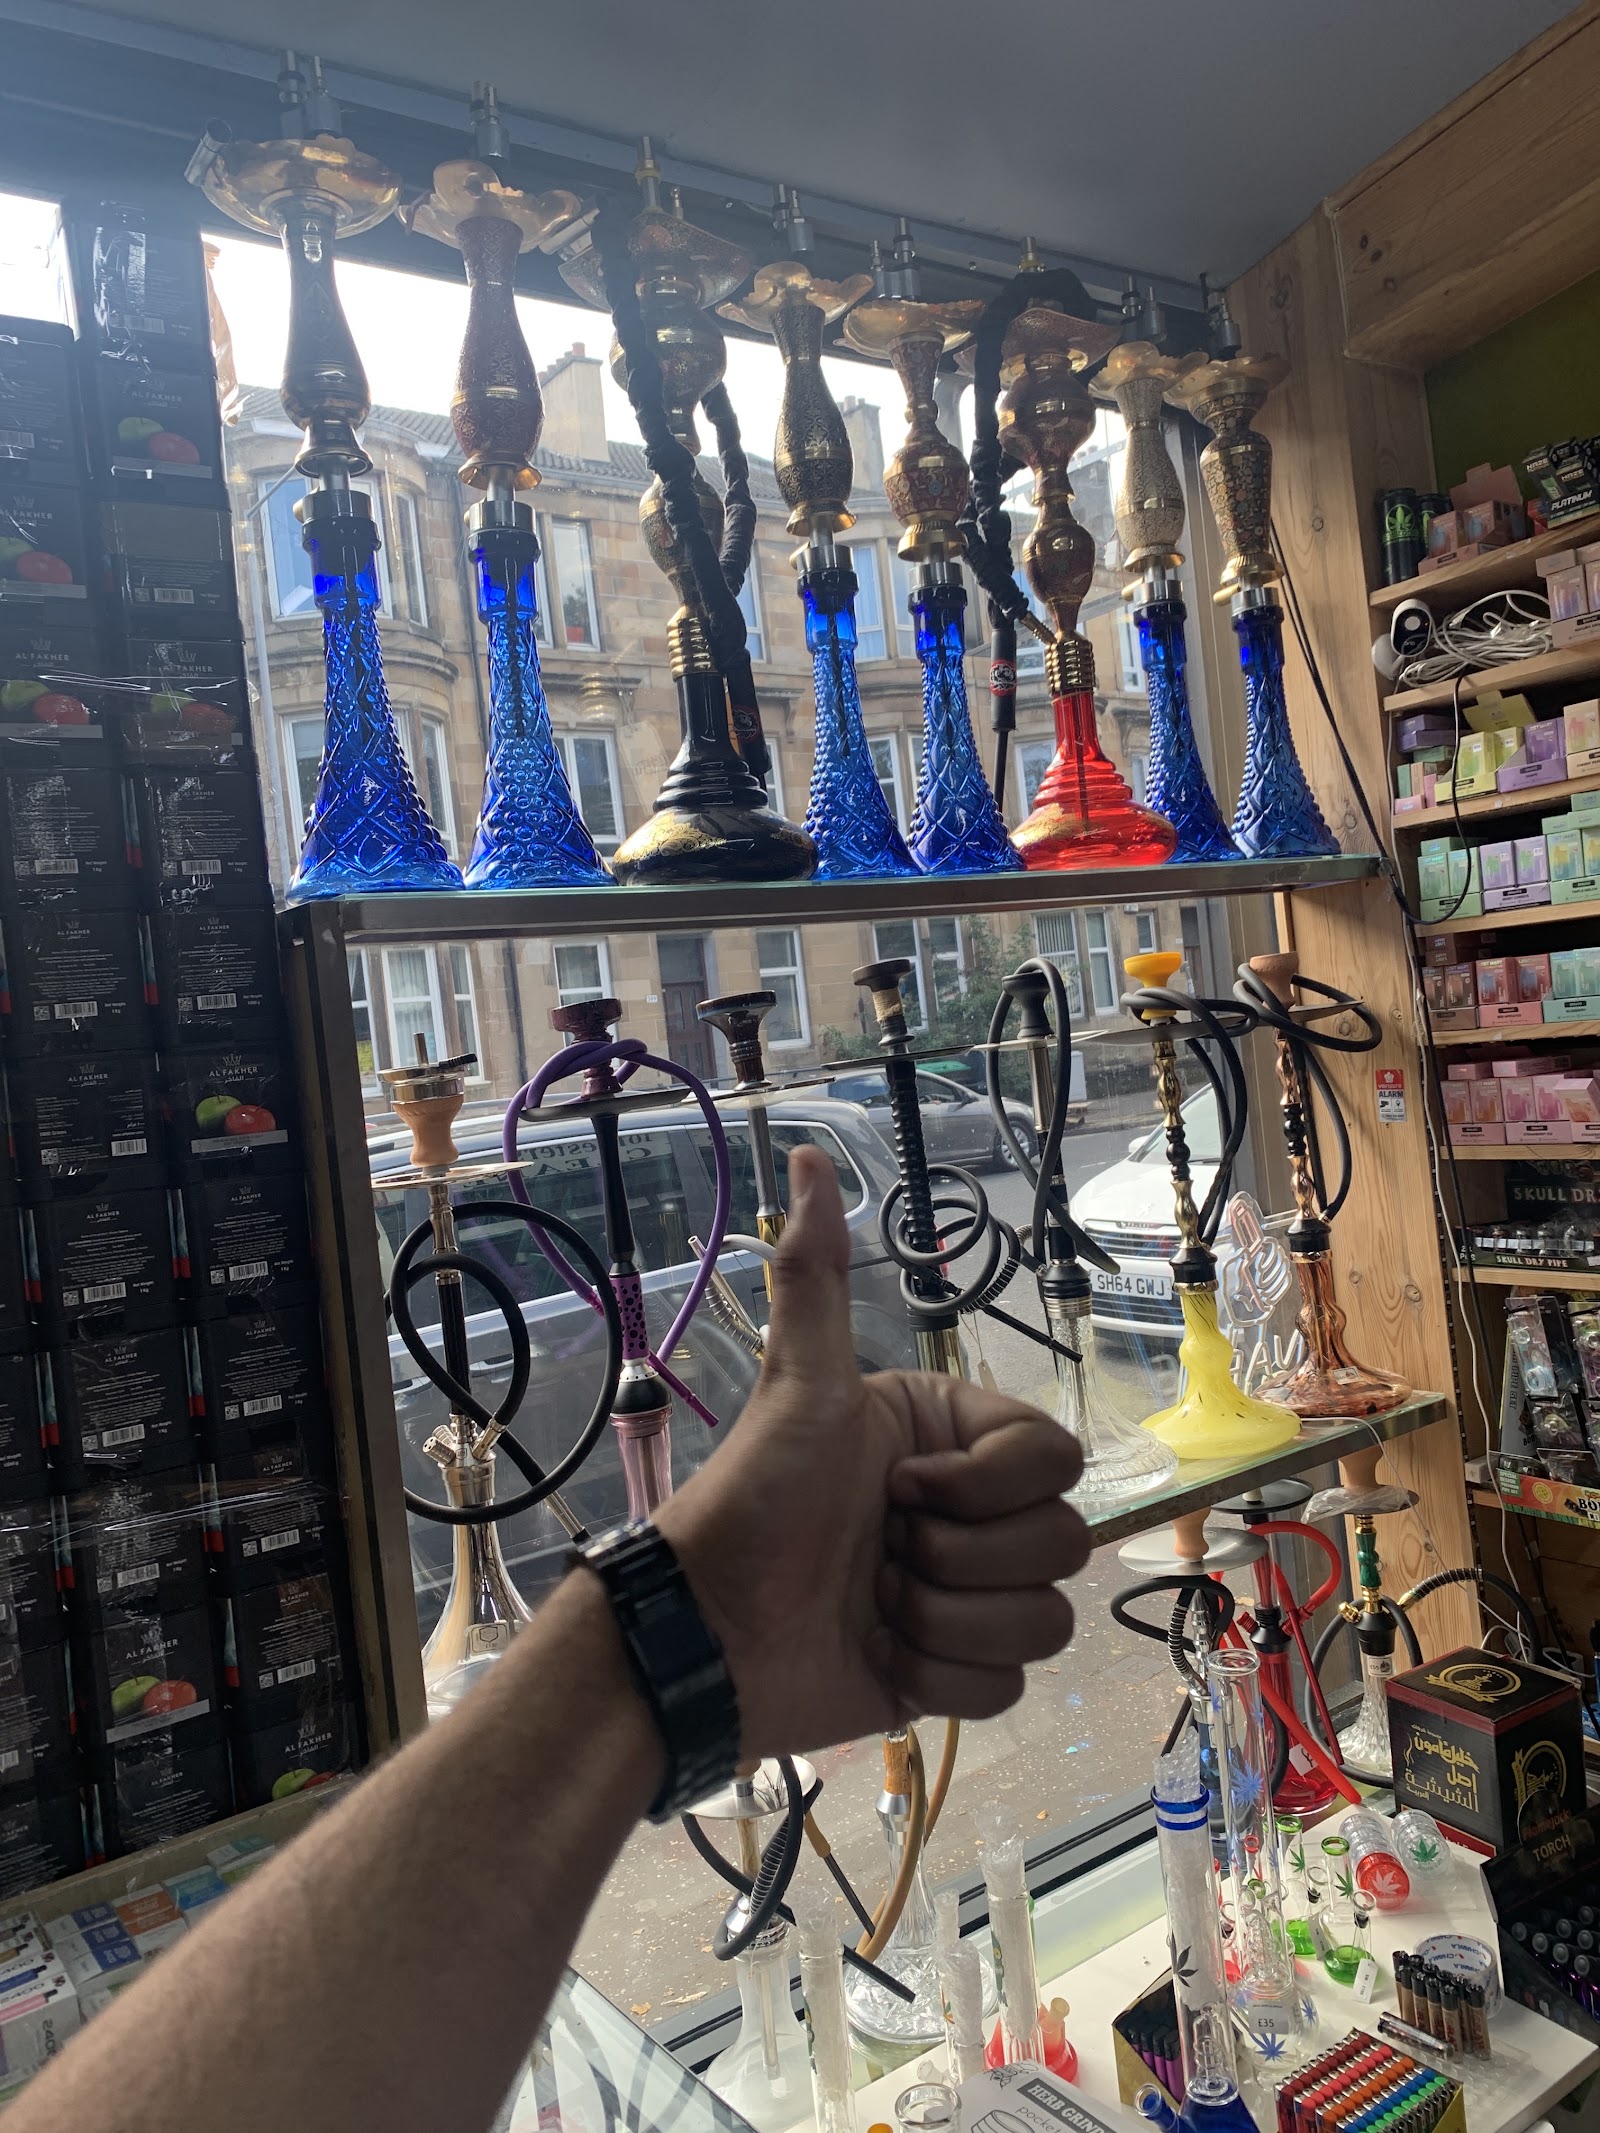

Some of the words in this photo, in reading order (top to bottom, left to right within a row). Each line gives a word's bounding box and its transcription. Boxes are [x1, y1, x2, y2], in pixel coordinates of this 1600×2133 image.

[1551, 490, 1593, 511] PLATINUM
[13, 509, 53, 520] FAKHER
[30, 653, 70, 662] FAKHER
[79, 1073, 109, 1082] FAKHER
[223, 1066, 259, 1076] FAKHER
[1514, 1187, 1567, 1201] SKULL
[95, 1210, 120, 1219] FAKHER
[1496, 1255, 1524, 1265] SKULL
[1524, 1257, 1545, 1266] DRY
[1547, 1258, 1568, 1268] PIPE
[1097, 1274, 1133, 1293] SH64
[1136, 1277, 1165, 1296] GWJ
[113, 1352, 138, 1362] FAKHER
[271, 1461, 293, 1470] FAKHER
[1577, 1497, 1600, 1511] BO
[126, 1651, 138, 1660] AL
[140, 1638, 178, 1654] FAKHER
[285, 1744, 296, 1754] AL
[297, 1732, 333, 1749] FAKHER
[1532, 1834, 1572, 1862] TORCH
[1257, 2018, 1275, 2028] £35
[1028, 2084, 1063, 2111] HERB
